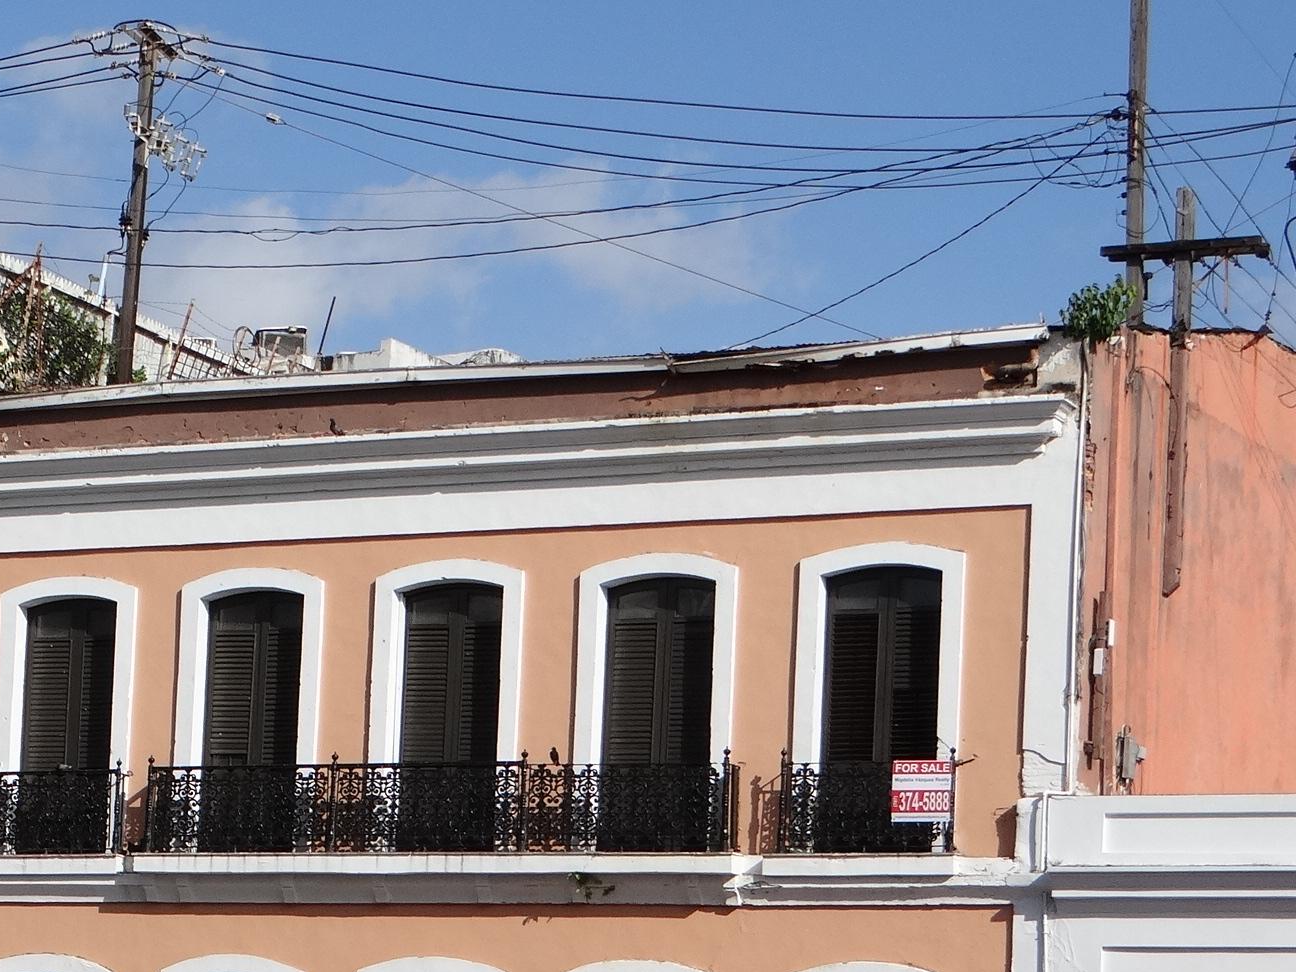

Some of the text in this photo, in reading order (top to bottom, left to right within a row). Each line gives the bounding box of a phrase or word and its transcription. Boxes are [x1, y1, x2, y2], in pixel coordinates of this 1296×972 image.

[895, 763, 950, 773] FOR SALE
[899, 791, 950, 811] 374-5888
